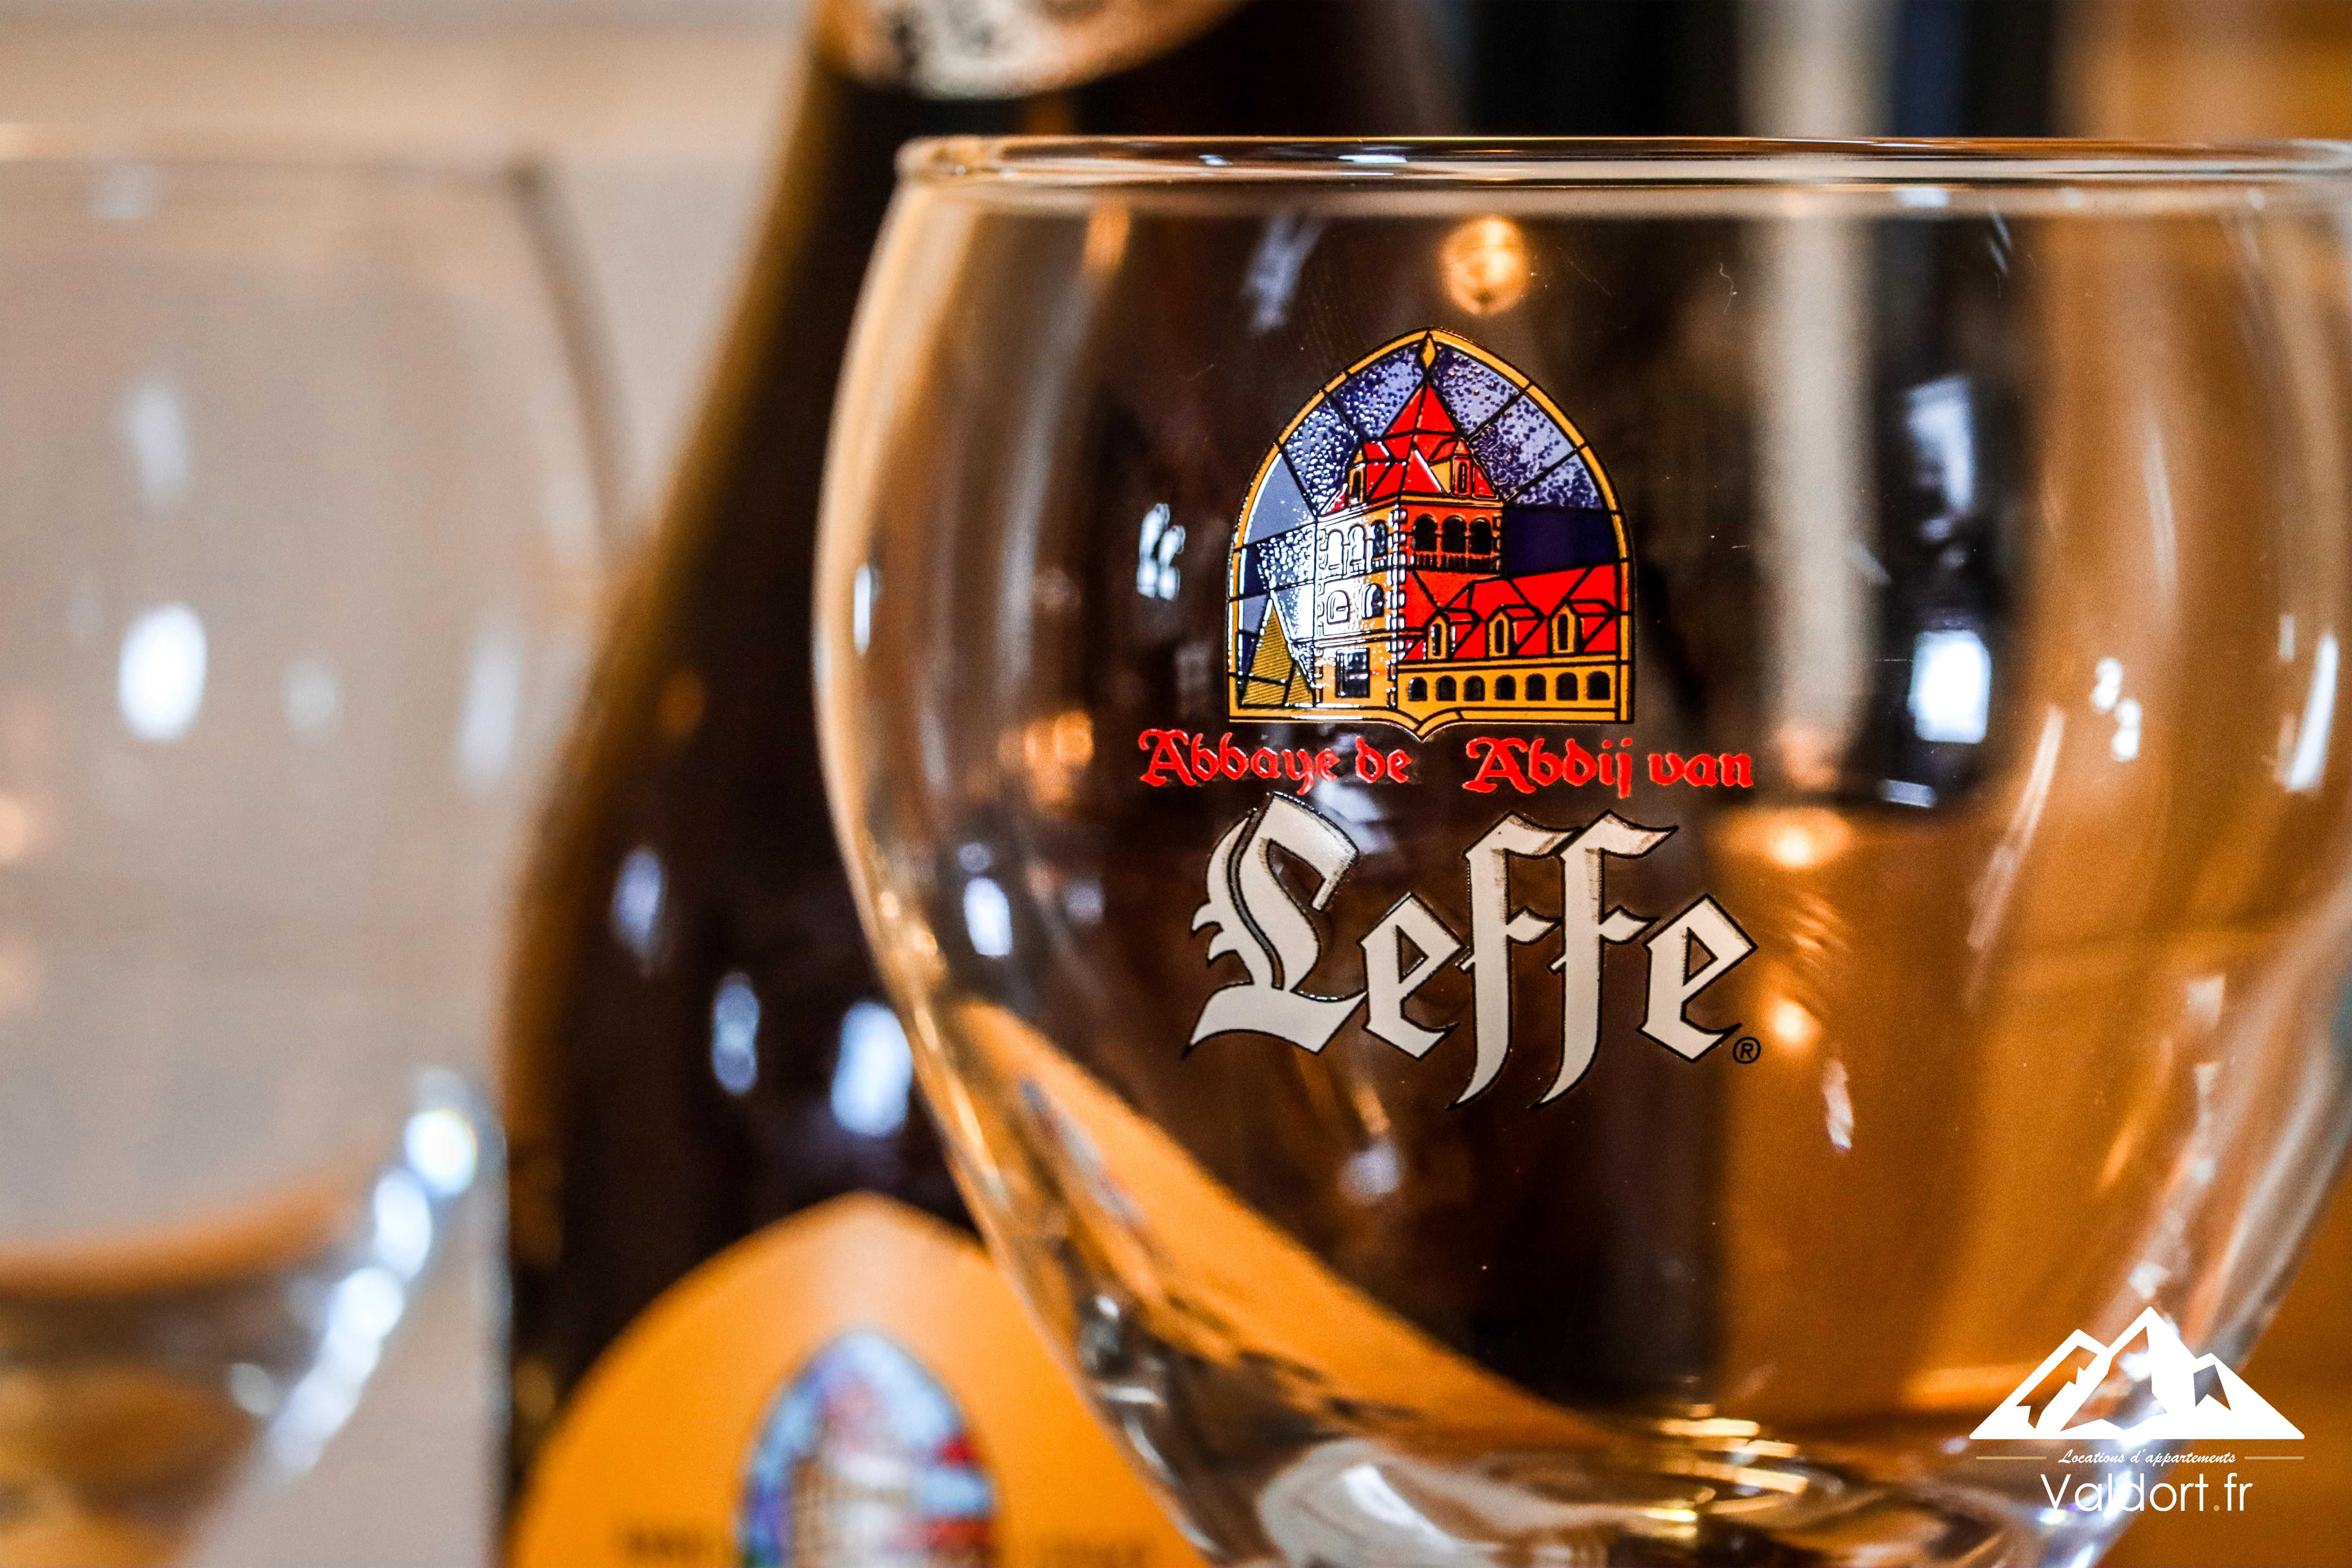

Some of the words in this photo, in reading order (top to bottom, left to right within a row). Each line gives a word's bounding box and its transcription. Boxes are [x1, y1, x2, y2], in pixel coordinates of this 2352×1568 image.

[1138, 728, 1340, 795] Abbaye
[1355, 736, 1413, 783] de
[1462, 737, 1632, 799] Abdij
[1648, 753, 1754, 788] van
[1181, 791, 1758, 1111] Leffe
